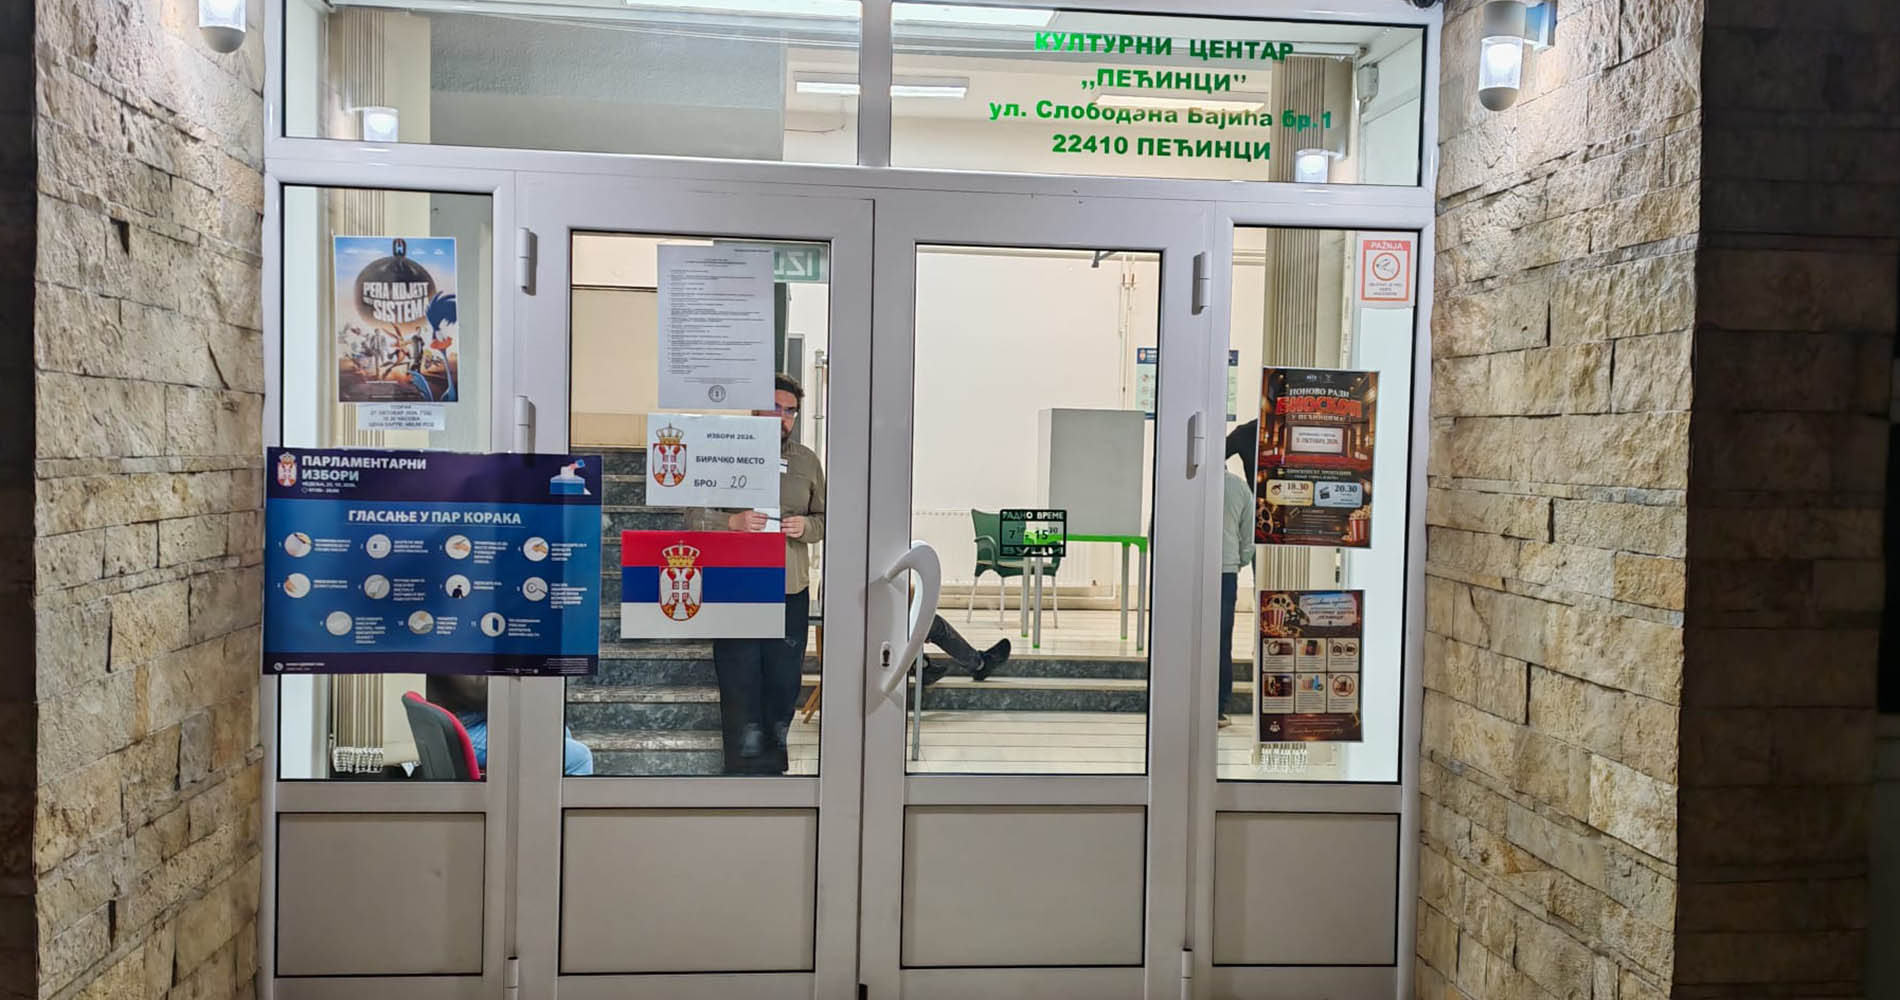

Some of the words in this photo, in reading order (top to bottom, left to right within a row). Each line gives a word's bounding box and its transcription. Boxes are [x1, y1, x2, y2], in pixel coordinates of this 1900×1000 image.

[1034, 32, 1172, 56] КУЛТУРНИ
[1189, 40, 1293, 61] ЦЕНТАР
[989, 101, 1027, 121] ул.
[1036, 100, 1178, 124] Слободана
[1188, 107, 1273, 131] Бајића
[1282, 109, 1332, 134] бр.1
[1052, 135, 1128, 155] 22410
[1137, 137, 1271, 161] ПЕЋИНЦИ
[363, 282, 389, 299] PERA
[1289, 387, 1326, 396] ПОНОВО
[1327, 388, 1350, 398] РАДИ
[1276, 396, 1362, 417] БИОСКОП
[706, 432, 735, 440] ИЗБОРИ
[301, 455, 427, 470] ПАРЛАМЕНТАРНИ
[696, 455, 734, 464] БИРАЧКО
[736, 456, 765, 465] МЕСТО
[302, 469, 359, 481] ИЗБОРИ
[730, 475, 747, 489] 20
[694, 479, 717, 488] БРОЈ
[1287, 483, 1309, 491] 18.30
[1334, 484, 1358, 493] 20.30
[349, 510, 417, 523] ГЛАСАЊЕ
[419, 511, 431, 523] У
[432, 512, 460, 524] ПАР
[463, 512, 522, 525] КОРАКА
